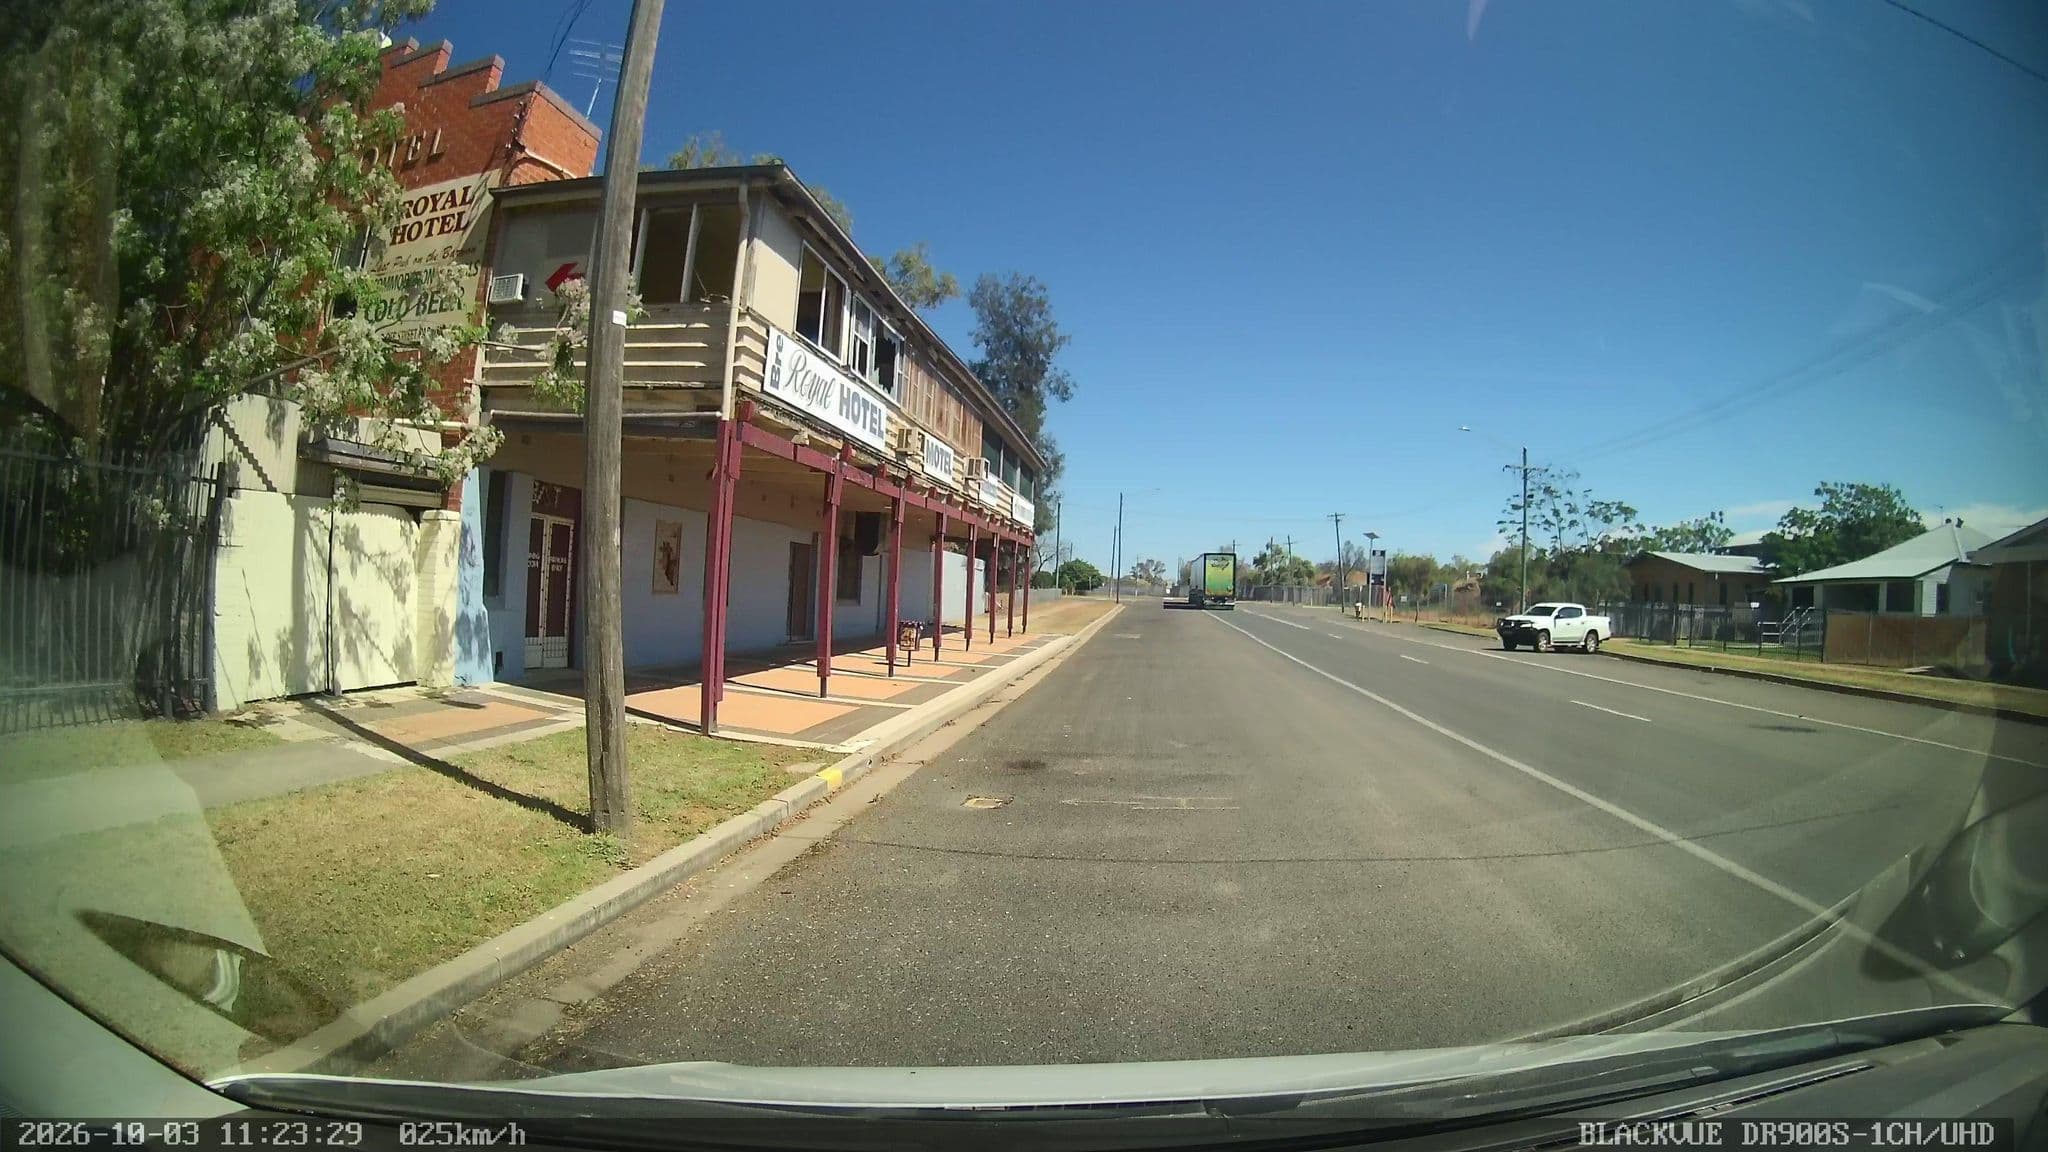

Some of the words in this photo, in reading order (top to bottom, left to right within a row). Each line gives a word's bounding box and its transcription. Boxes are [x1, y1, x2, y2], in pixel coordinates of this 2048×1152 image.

[401, 185, 474, 219] ROYAL
[389, 210, 470, 246] HOTEL
[784, 348, 837, 410] Royal
[838, 382, 885, 440] HOTEL
[925, 438, 953, 476] MOTEL
